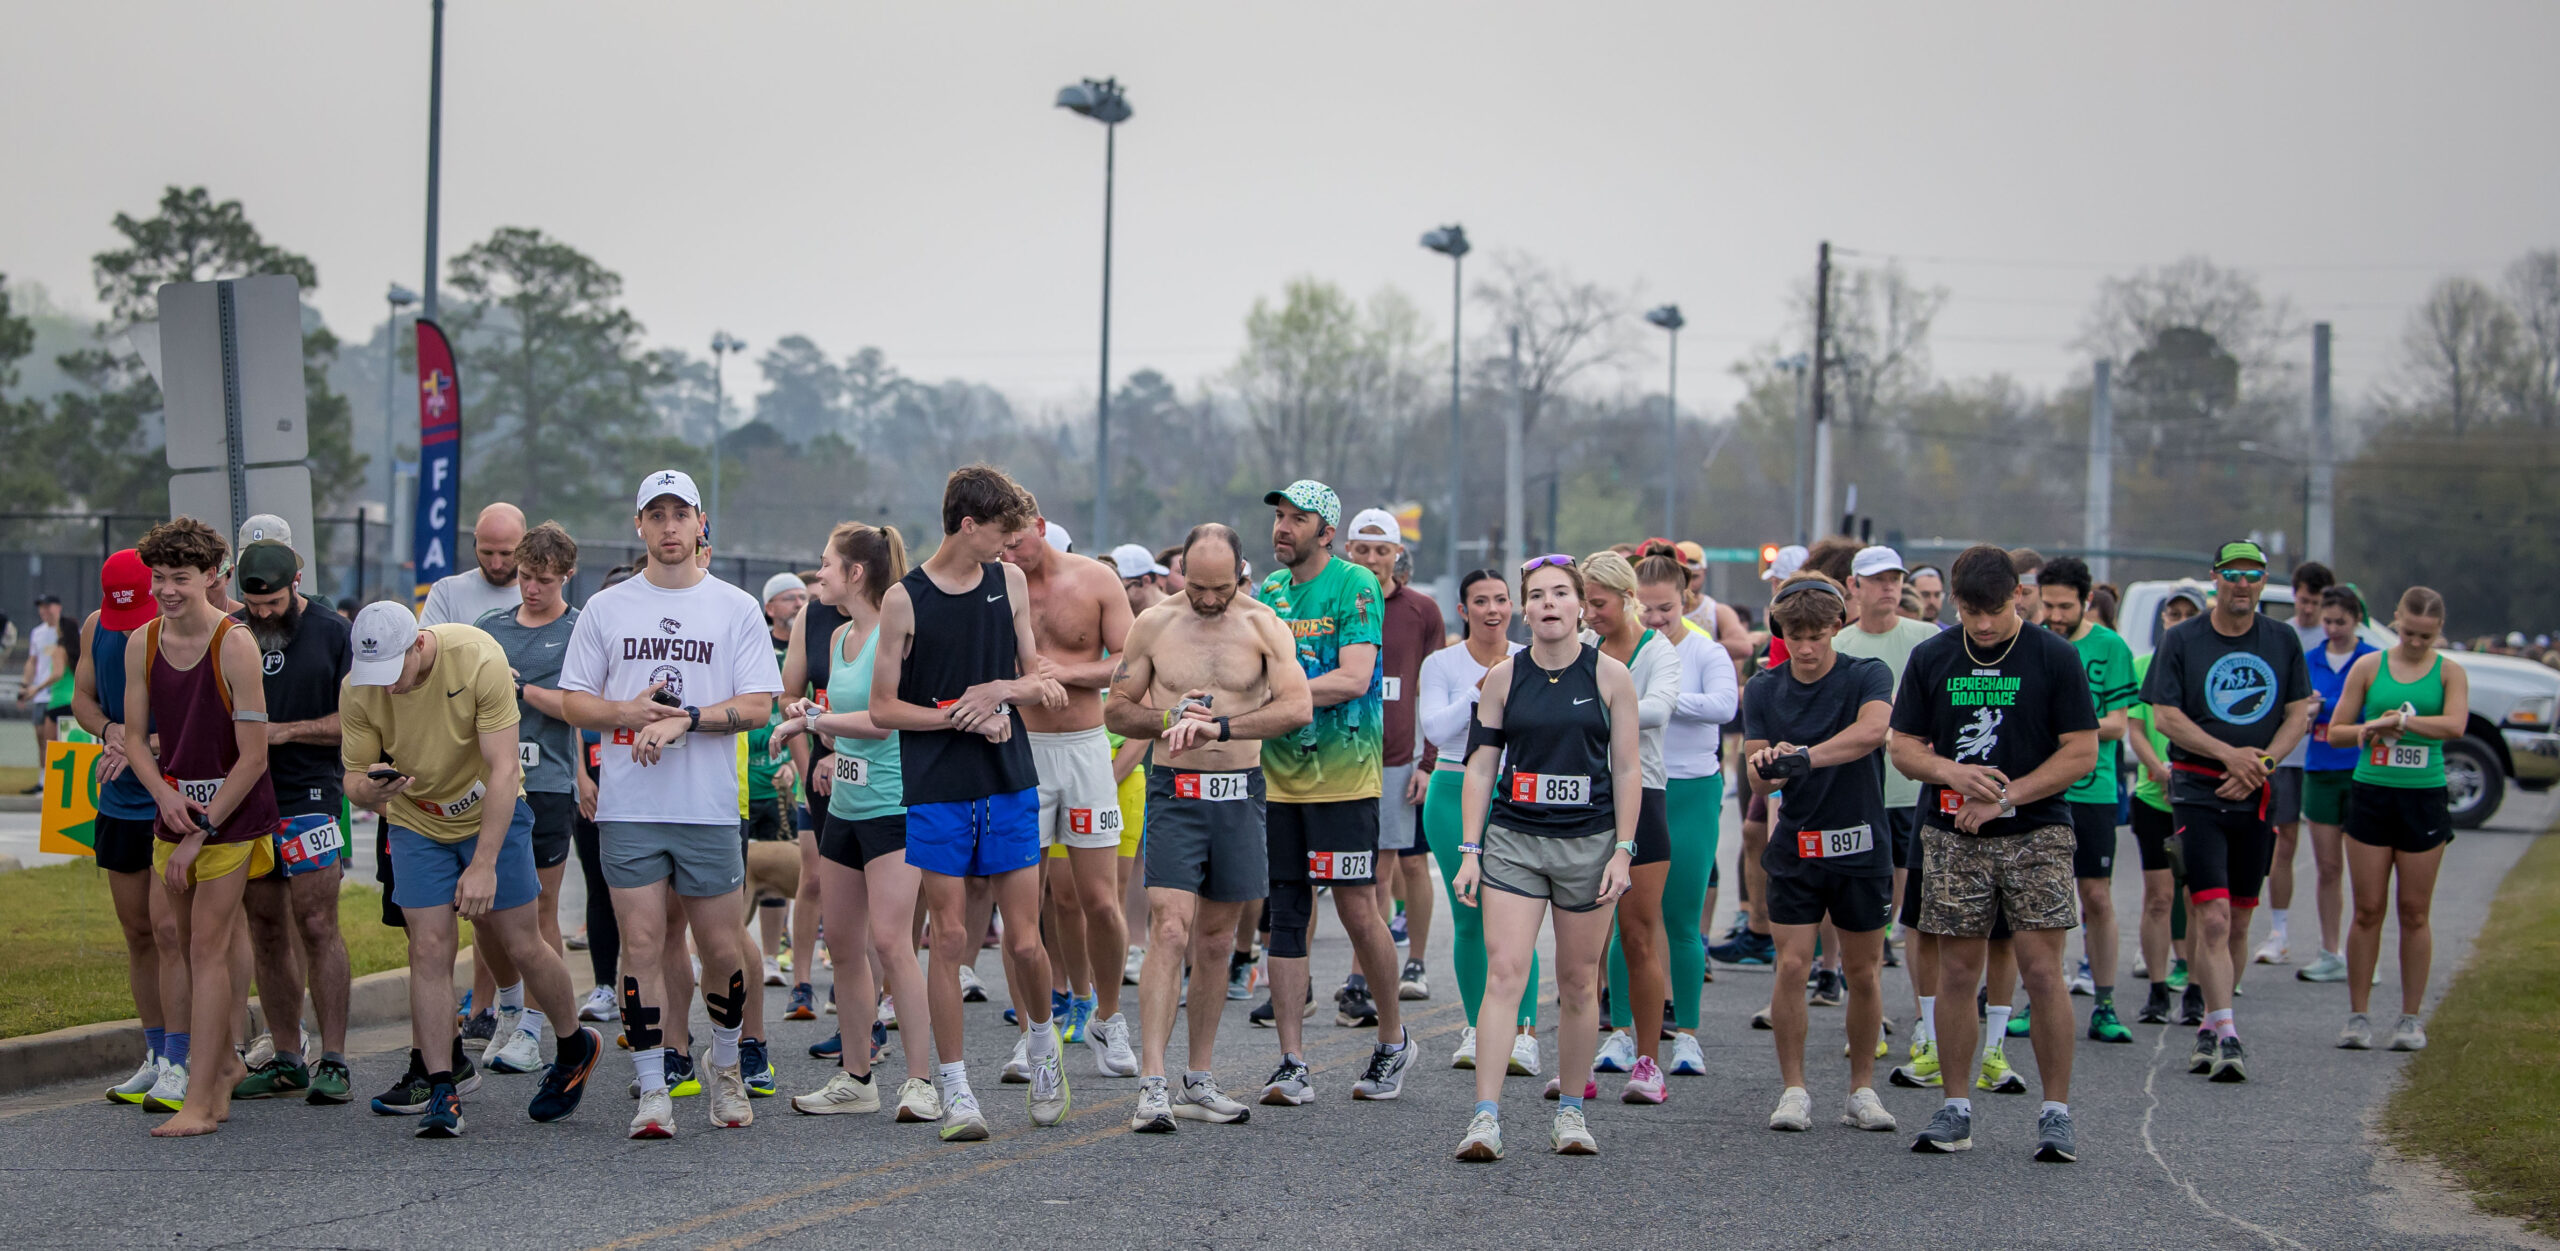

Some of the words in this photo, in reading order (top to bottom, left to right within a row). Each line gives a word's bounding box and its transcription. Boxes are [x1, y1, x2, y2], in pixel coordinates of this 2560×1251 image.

[422, 457, 449, 569] FCA
[116, 596, 133, 604] MORE
[121, 589, 135, 597] ONE
[623, 637, 715, 665] DAWSON
[1946, 676, 2022, 691] LEPRECHAUN
[1951, 691, 1985, 706] ROAD
[1985, 691, 2017, 706] RACE
[2395, 747, 2422, 766] 896
[836, 757, 859, 782] 886
[185, 783, 218, 804] 882
[1209, 777, 1238, 798] 871
[1545, 778, 1580, 801] 853
[448, 790, 480, 816] 884
[1099, 809, 1119, 831] 903
[309, 826, 336, 852] 927
[1830, 830, 1862, 854] 897
[1341, 855, 1367, 876] 873
